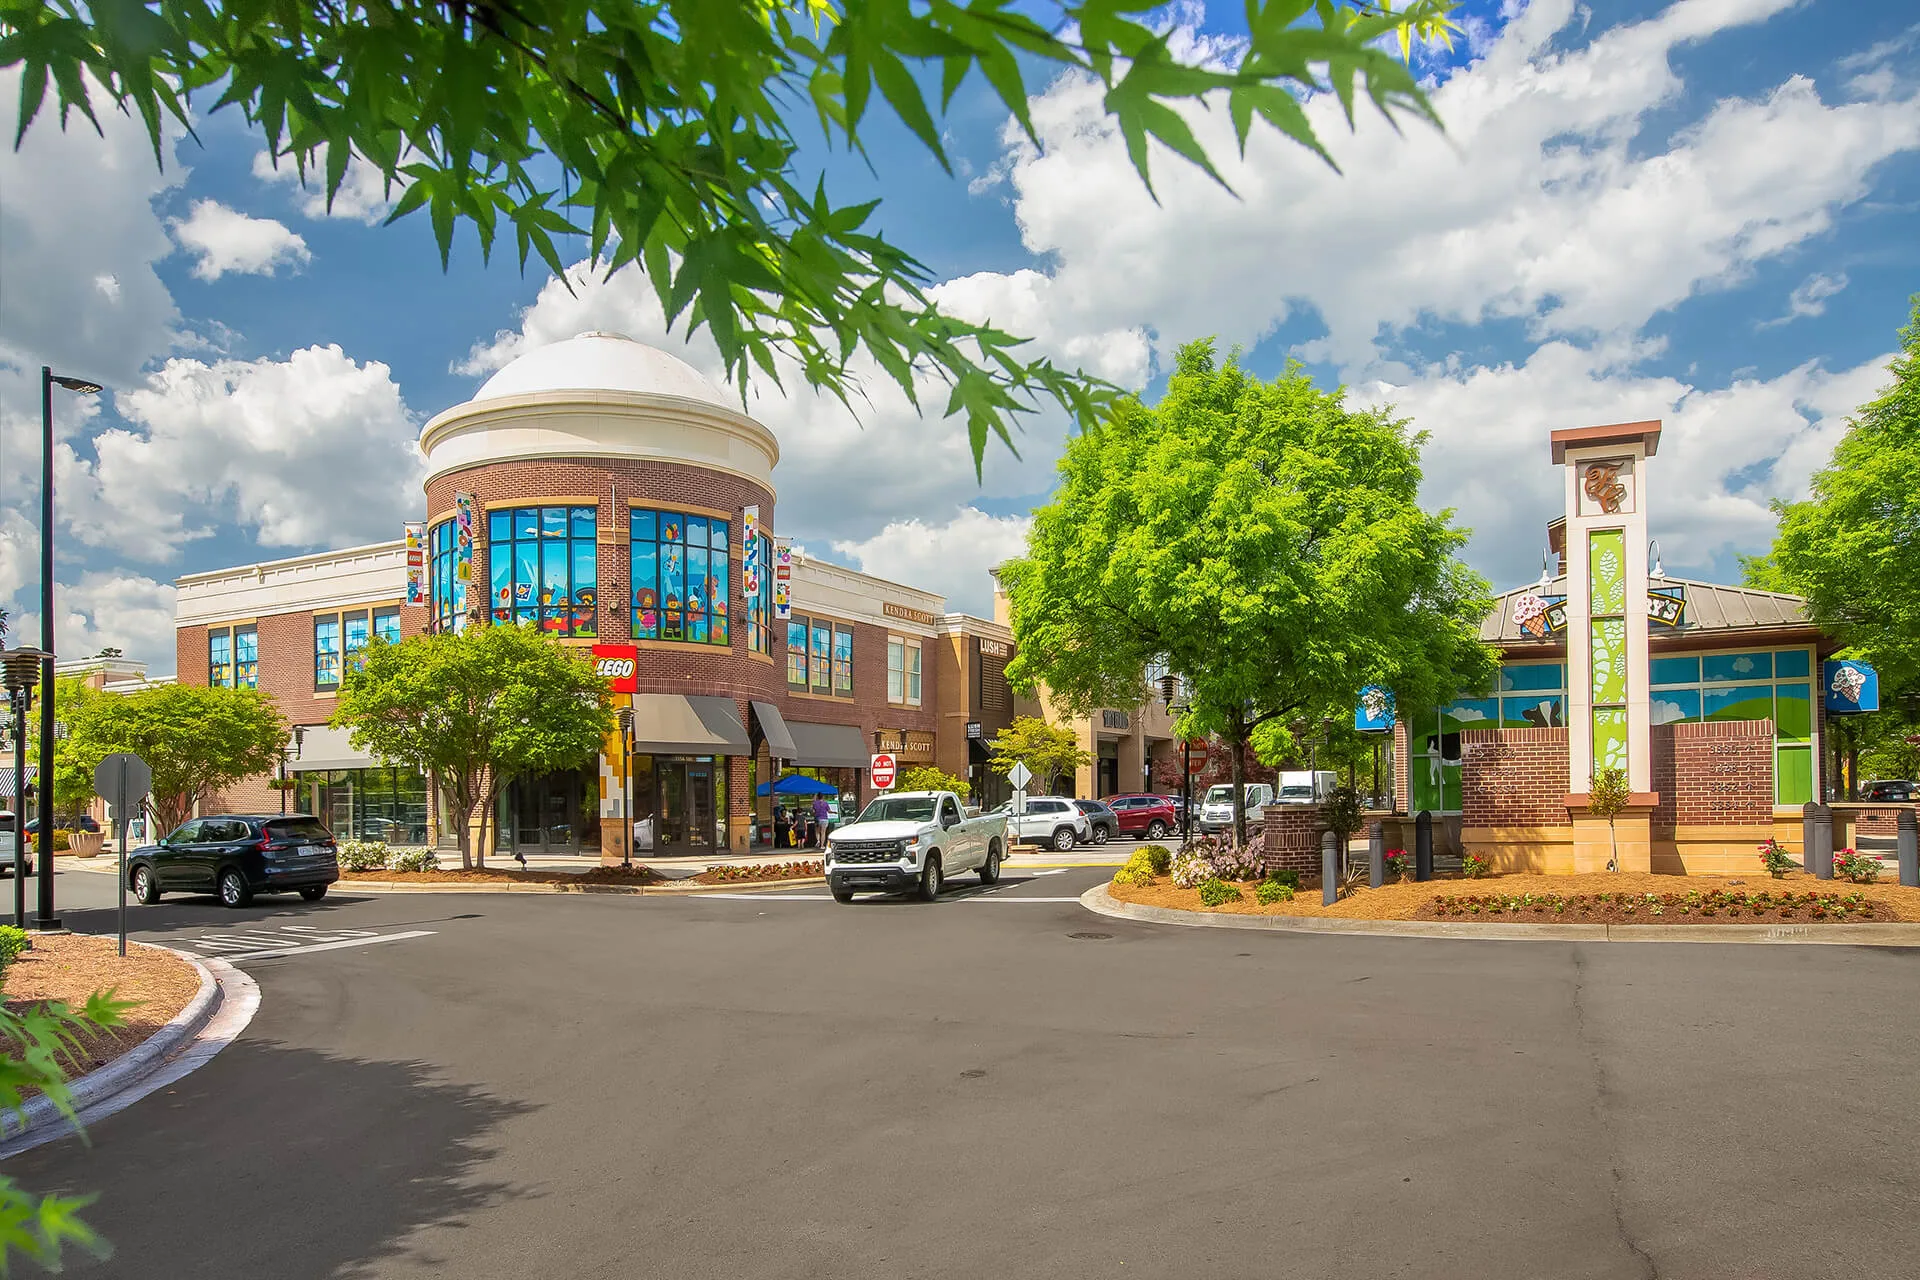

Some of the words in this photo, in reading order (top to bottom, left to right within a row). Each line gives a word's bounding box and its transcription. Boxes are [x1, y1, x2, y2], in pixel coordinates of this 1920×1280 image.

[885, 604, 912, 618] KENDRA
[913, 611, 934, 625] SCOTT
[980, 638, 999, 655] LUSH
[596, 659, 634, 677] LEGO
[910, 742, 930, 752] SCOTT
